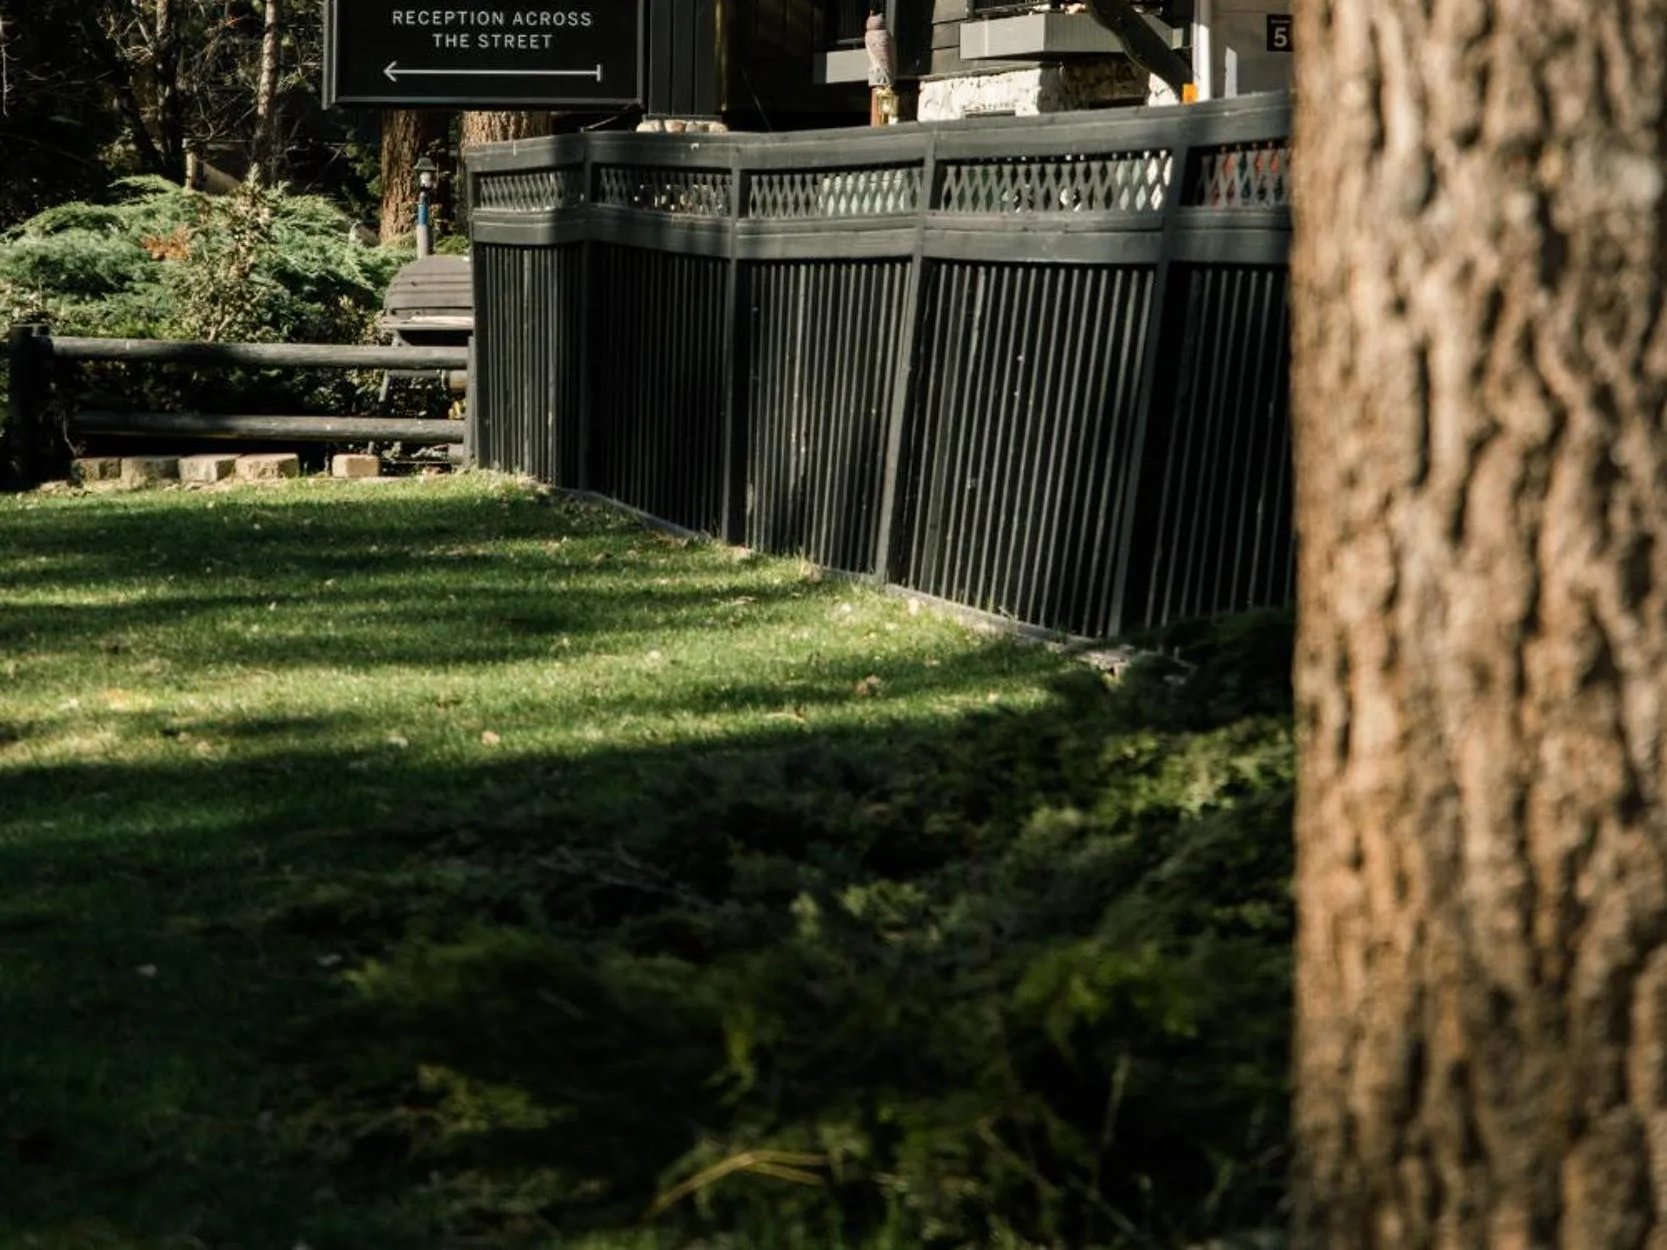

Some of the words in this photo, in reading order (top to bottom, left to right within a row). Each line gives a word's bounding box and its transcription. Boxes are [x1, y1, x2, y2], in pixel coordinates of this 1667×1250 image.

[392, 10, 505, 26] RECEPTION
[512, 10, 592, 27] ACROSS
[432, 33, 470, 48] THE
[478, 33, 553, 49] STREET
